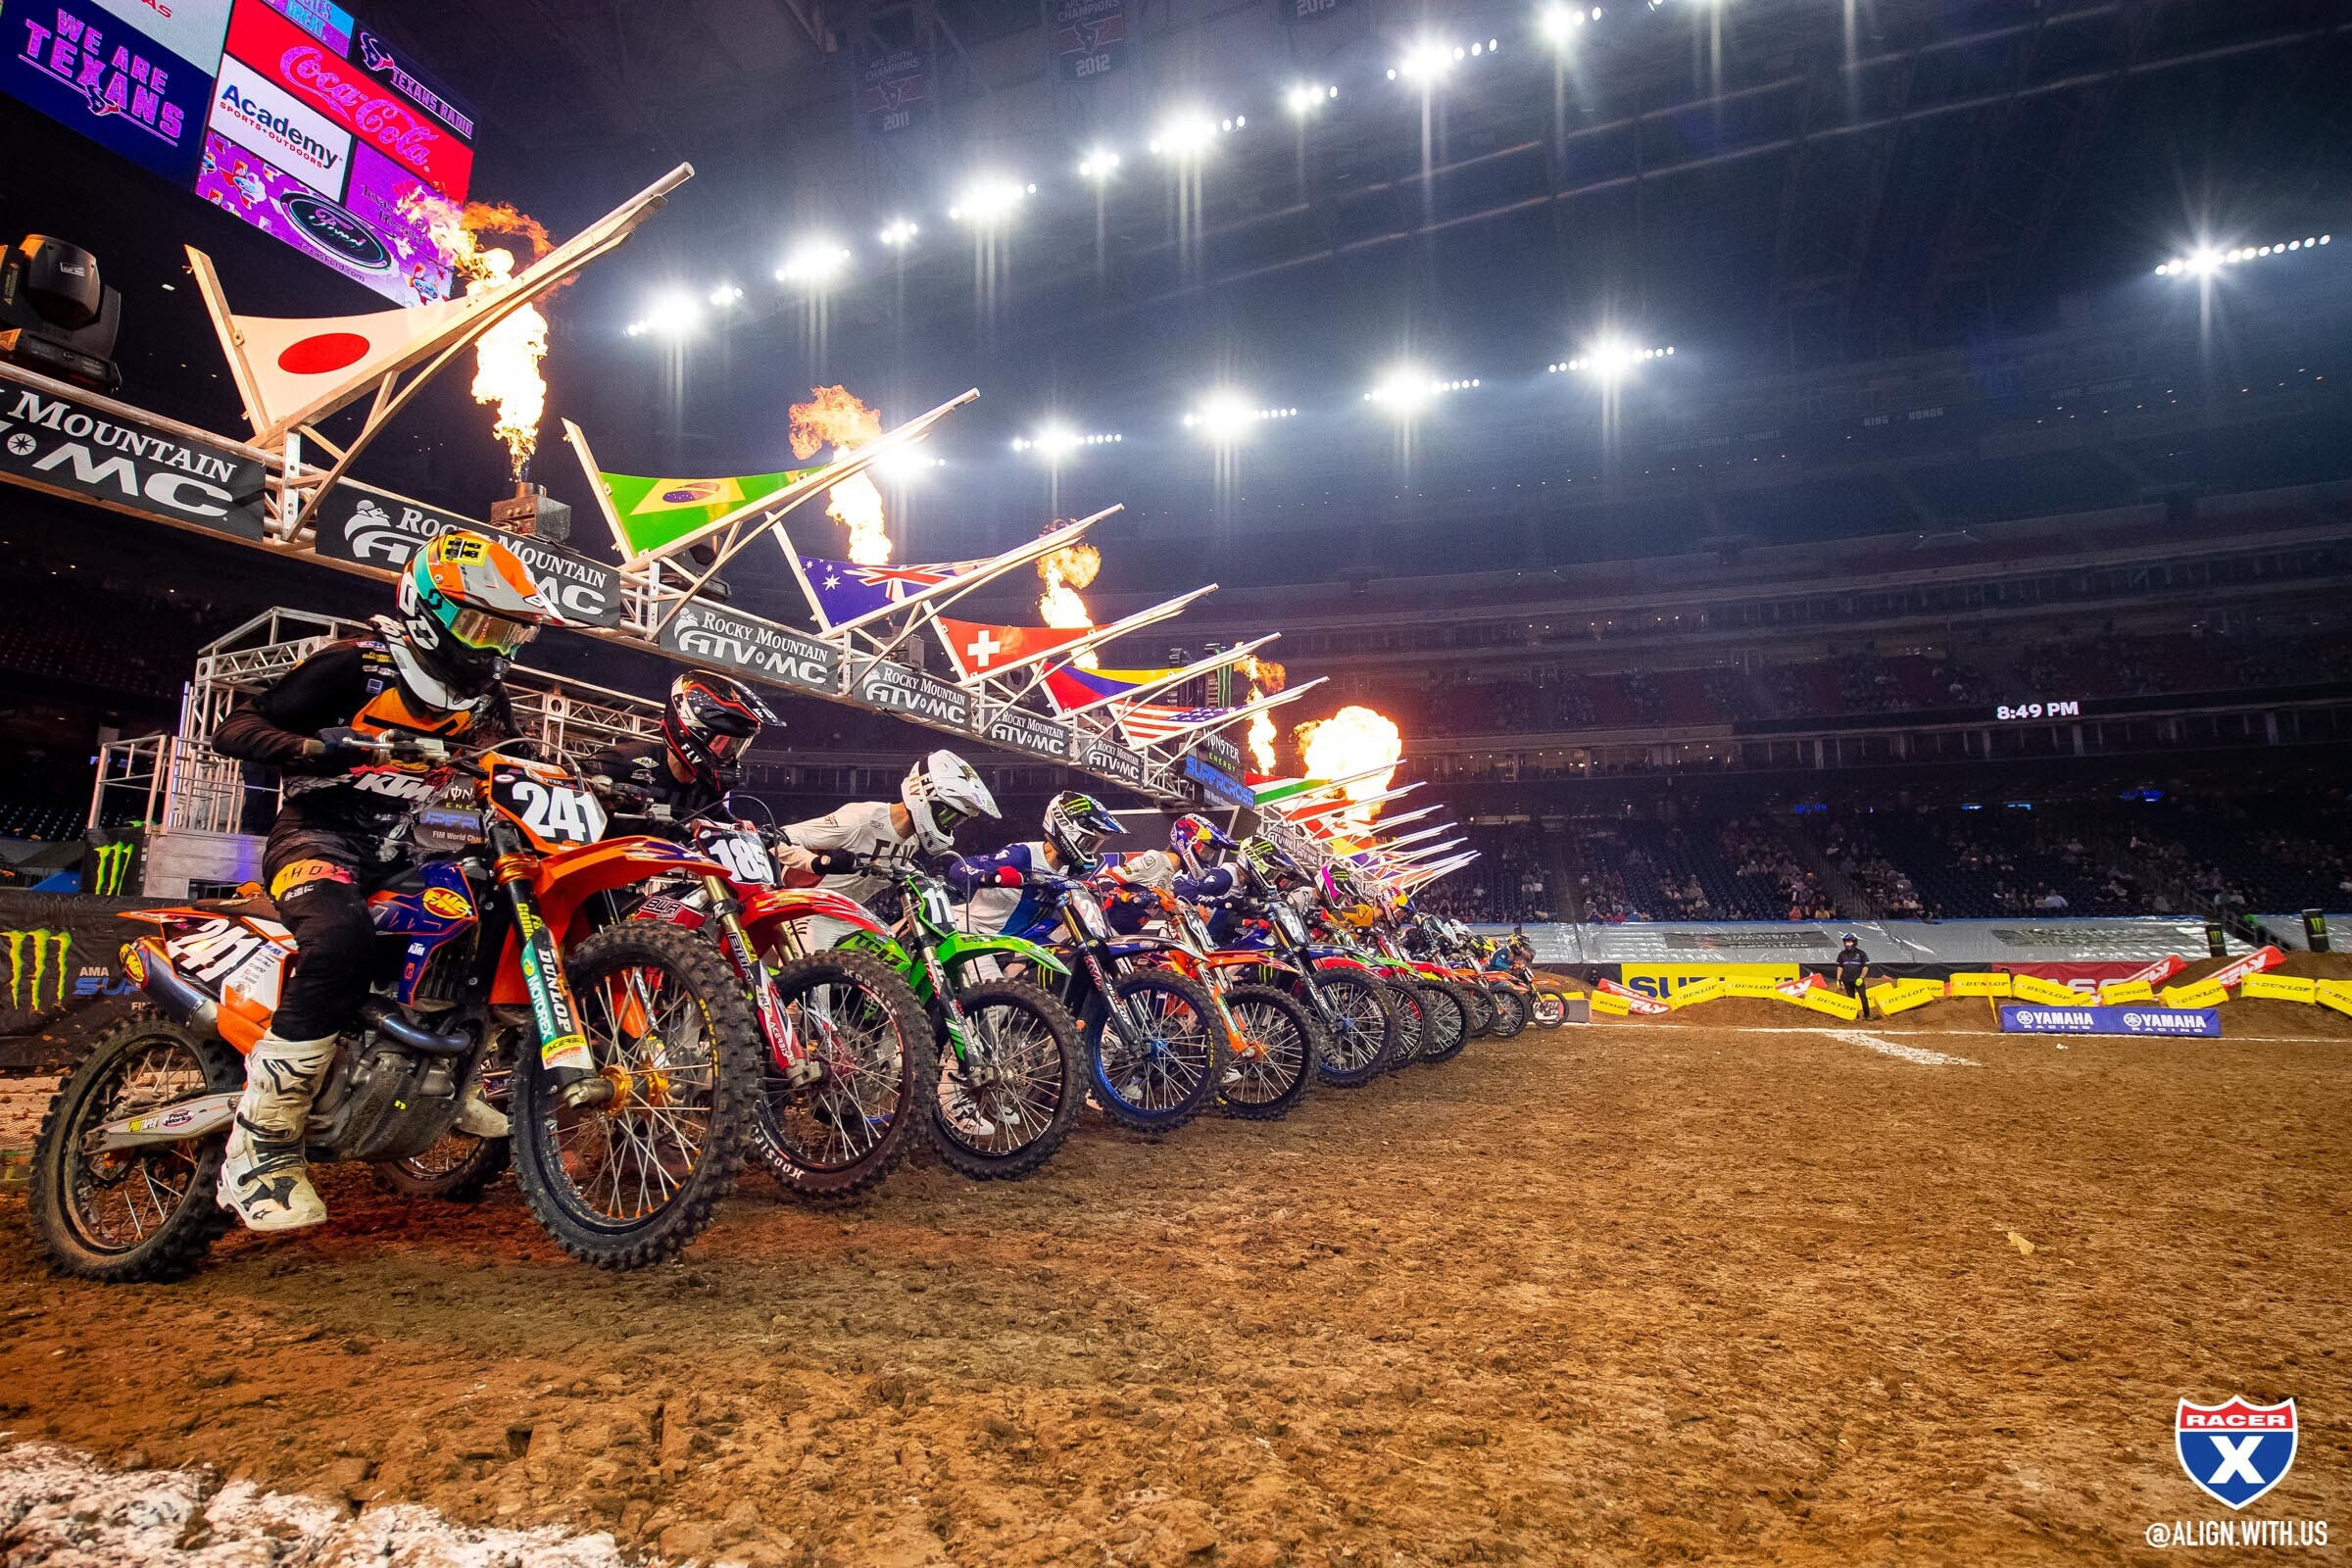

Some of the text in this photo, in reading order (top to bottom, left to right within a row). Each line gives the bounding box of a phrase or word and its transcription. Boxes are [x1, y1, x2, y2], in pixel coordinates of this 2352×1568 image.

[1057, 0, 1120, 23] CHAMPIONS
[57, 8, 169, 95] WE ARE
[25, 18, 185, 138] TEXANS
[1075, 53, 1111, 78] 2012
[280, 45, 439, 166] Coca-Cola
[391, 68, 474, 135] TEXANS RADIO
[221, 84, 339, 170] Academy
[883, 111, 910, 131] 2011
[308, 208, 367, 247] Ford
[298, 241, 366, 282] TexasFord.com
[7, 390, 238, 483] MOUNTAIN
[497, 534, 608, 589] MOUNTAIN
[703, 611, 828, 663] ROCKY MOUNTAIN
[882, 666, 966, 707] ROCKY MOUNTAIN
[1996, 701, 2080, 721] 8:49 PM
[1001, 711, 1064, 739] ROCKY MOUNTAIN
[680, 743, 703, 764] FLY
[1203, 727, 1240, 763] MONSTER
[1208, 752, 1236, 772] ENERGY
[353, 770, 435, 802] KTM
[909, 775, 921, 796] FLY
[1186, 755, 1254, 808] SUPERCROSS
[446, 802, 481, 812] ENE
[512, 781, 602, 844] 241
[432, 830, 446, 839] FIM
[447, 831, 466, 842] World
[870, 838, 915, 867] FLY
[165, 918, 264, 983] 241
[407, 943, 425, 956] KTM
[78, 966, 110, 977] AMA
[537, 948, 572, 1033] DUNLOP
[1683, 984, 1717, 999] DUNLOP
[1887, 986, 1926, 1004] DUNLOP
[2026, 985, 2071, 1001] DUNLOP
[2114, 988, 2149, 997] DUNLOP
[2181, 986, 2223, 1004] DUNLOP
[2260, 983, 2312, 992] DUNLOP
[525, 974, 555, 1039] MOTOREX
[1599, 1000, 1629, 1010] DUNLOP
[1817, 997, 1857, 1011] DUNLOP
[2033, 1011, 2094, 1025] YAMAHA
[2141, 1013, 2207, 1028] YAMAHA
